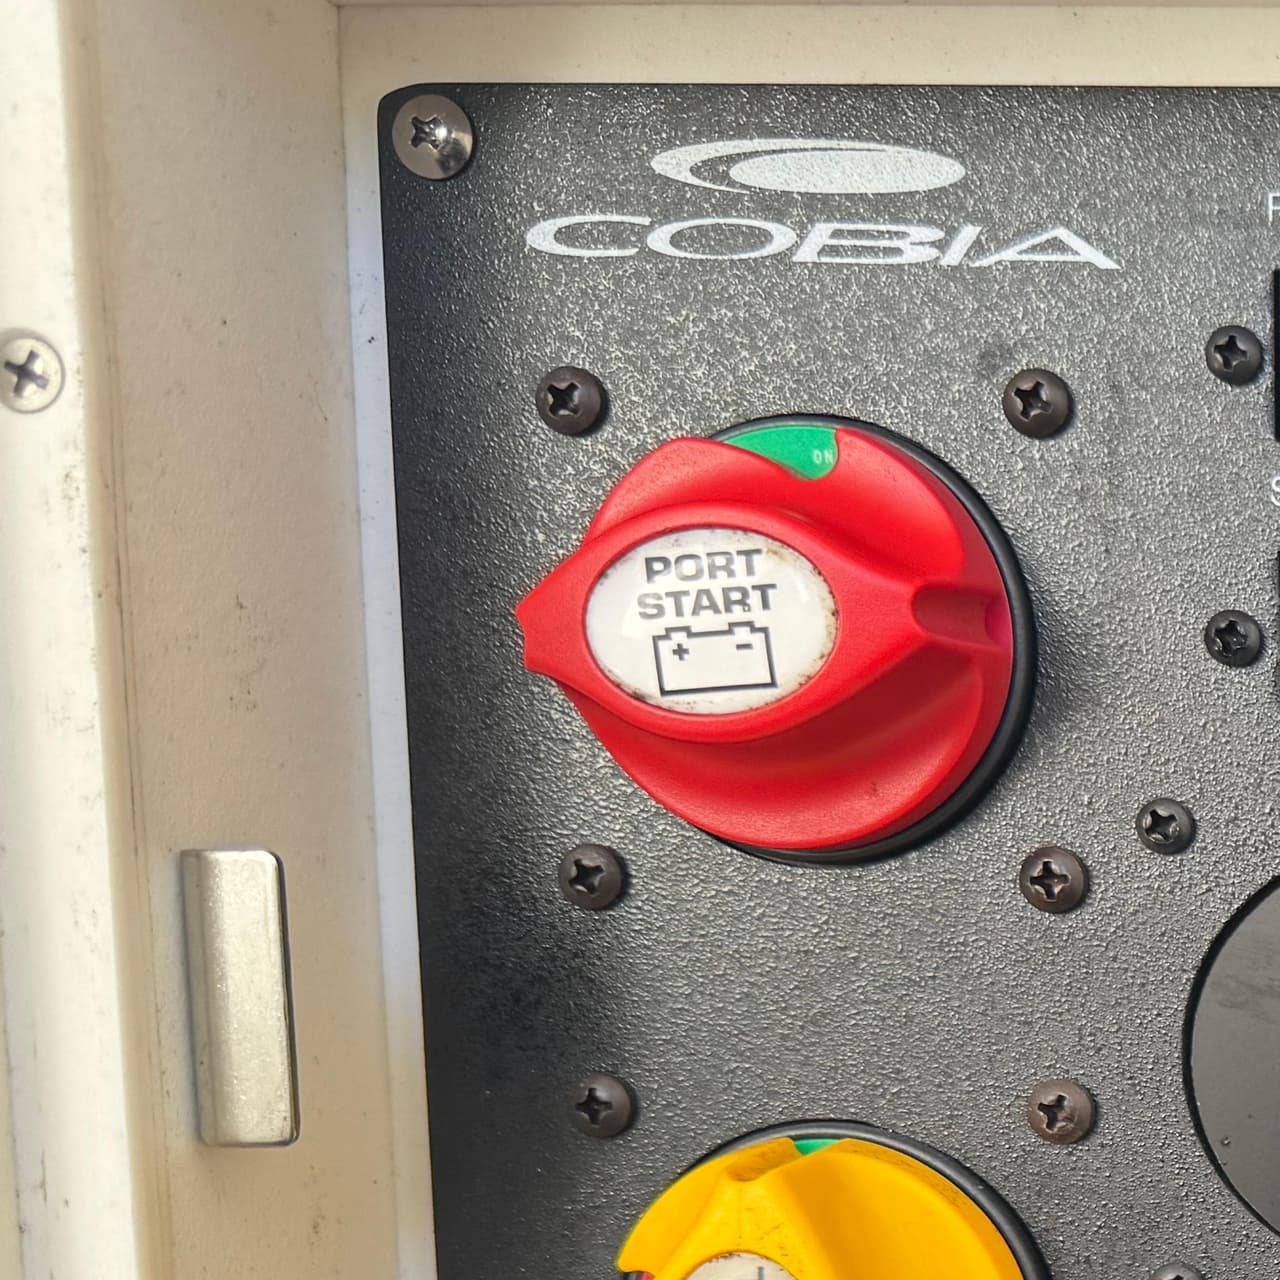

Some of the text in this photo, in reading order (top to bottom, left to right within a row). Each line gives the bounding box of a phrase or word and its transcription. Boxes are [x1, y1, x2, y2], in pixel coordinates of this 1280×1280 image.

[525, 214, 1121, 270] COBIA
[644, 548, 763, 584] PORT
[636, 583, 777, 620] START
